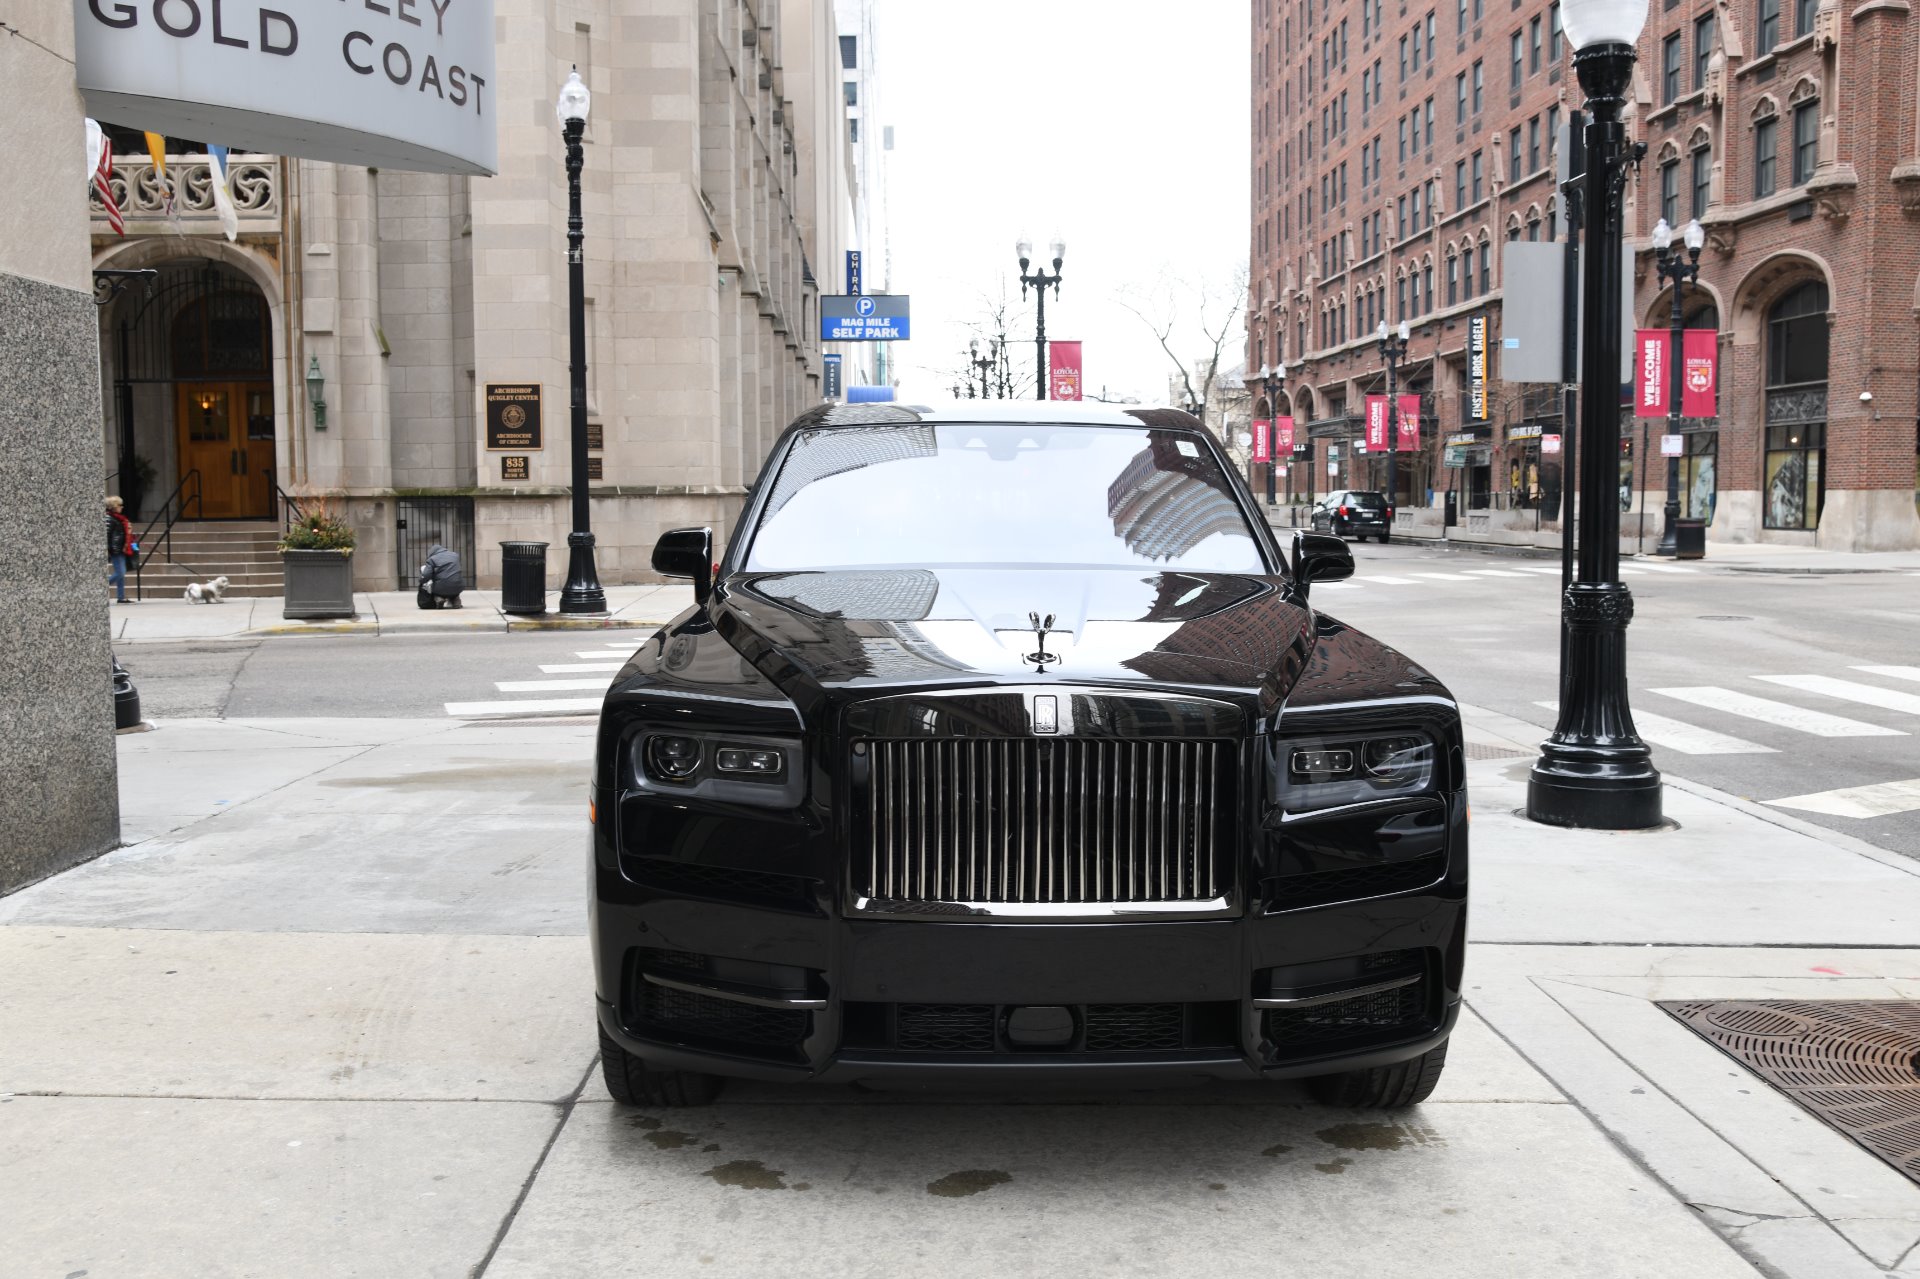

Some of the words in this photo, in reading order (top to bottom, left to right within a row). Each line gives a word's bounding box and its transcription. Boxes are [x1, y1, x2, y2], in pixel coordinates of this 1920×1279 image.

[87, 0, 299, 57] GOLD
[342, 30, 486, 116] COAST
[851, 252, 859, 295] GHIRA
[841, 318, 863, 327] MAG
[865, 318, 891, 327] MILE
[860, 299, 872, 314] P
[832, 327, 863, 338] SELF
[865, 327, 899, 338] PARK
[1472, 318, 1484, 352] BAGELS
[1644, 340, 1655, 407] WELCOME
[1471, 378, 1483, 418] EINSTEIN
[1371, 402, 1379, 445] WELCOME
[506, 457, 524, 468] 835
